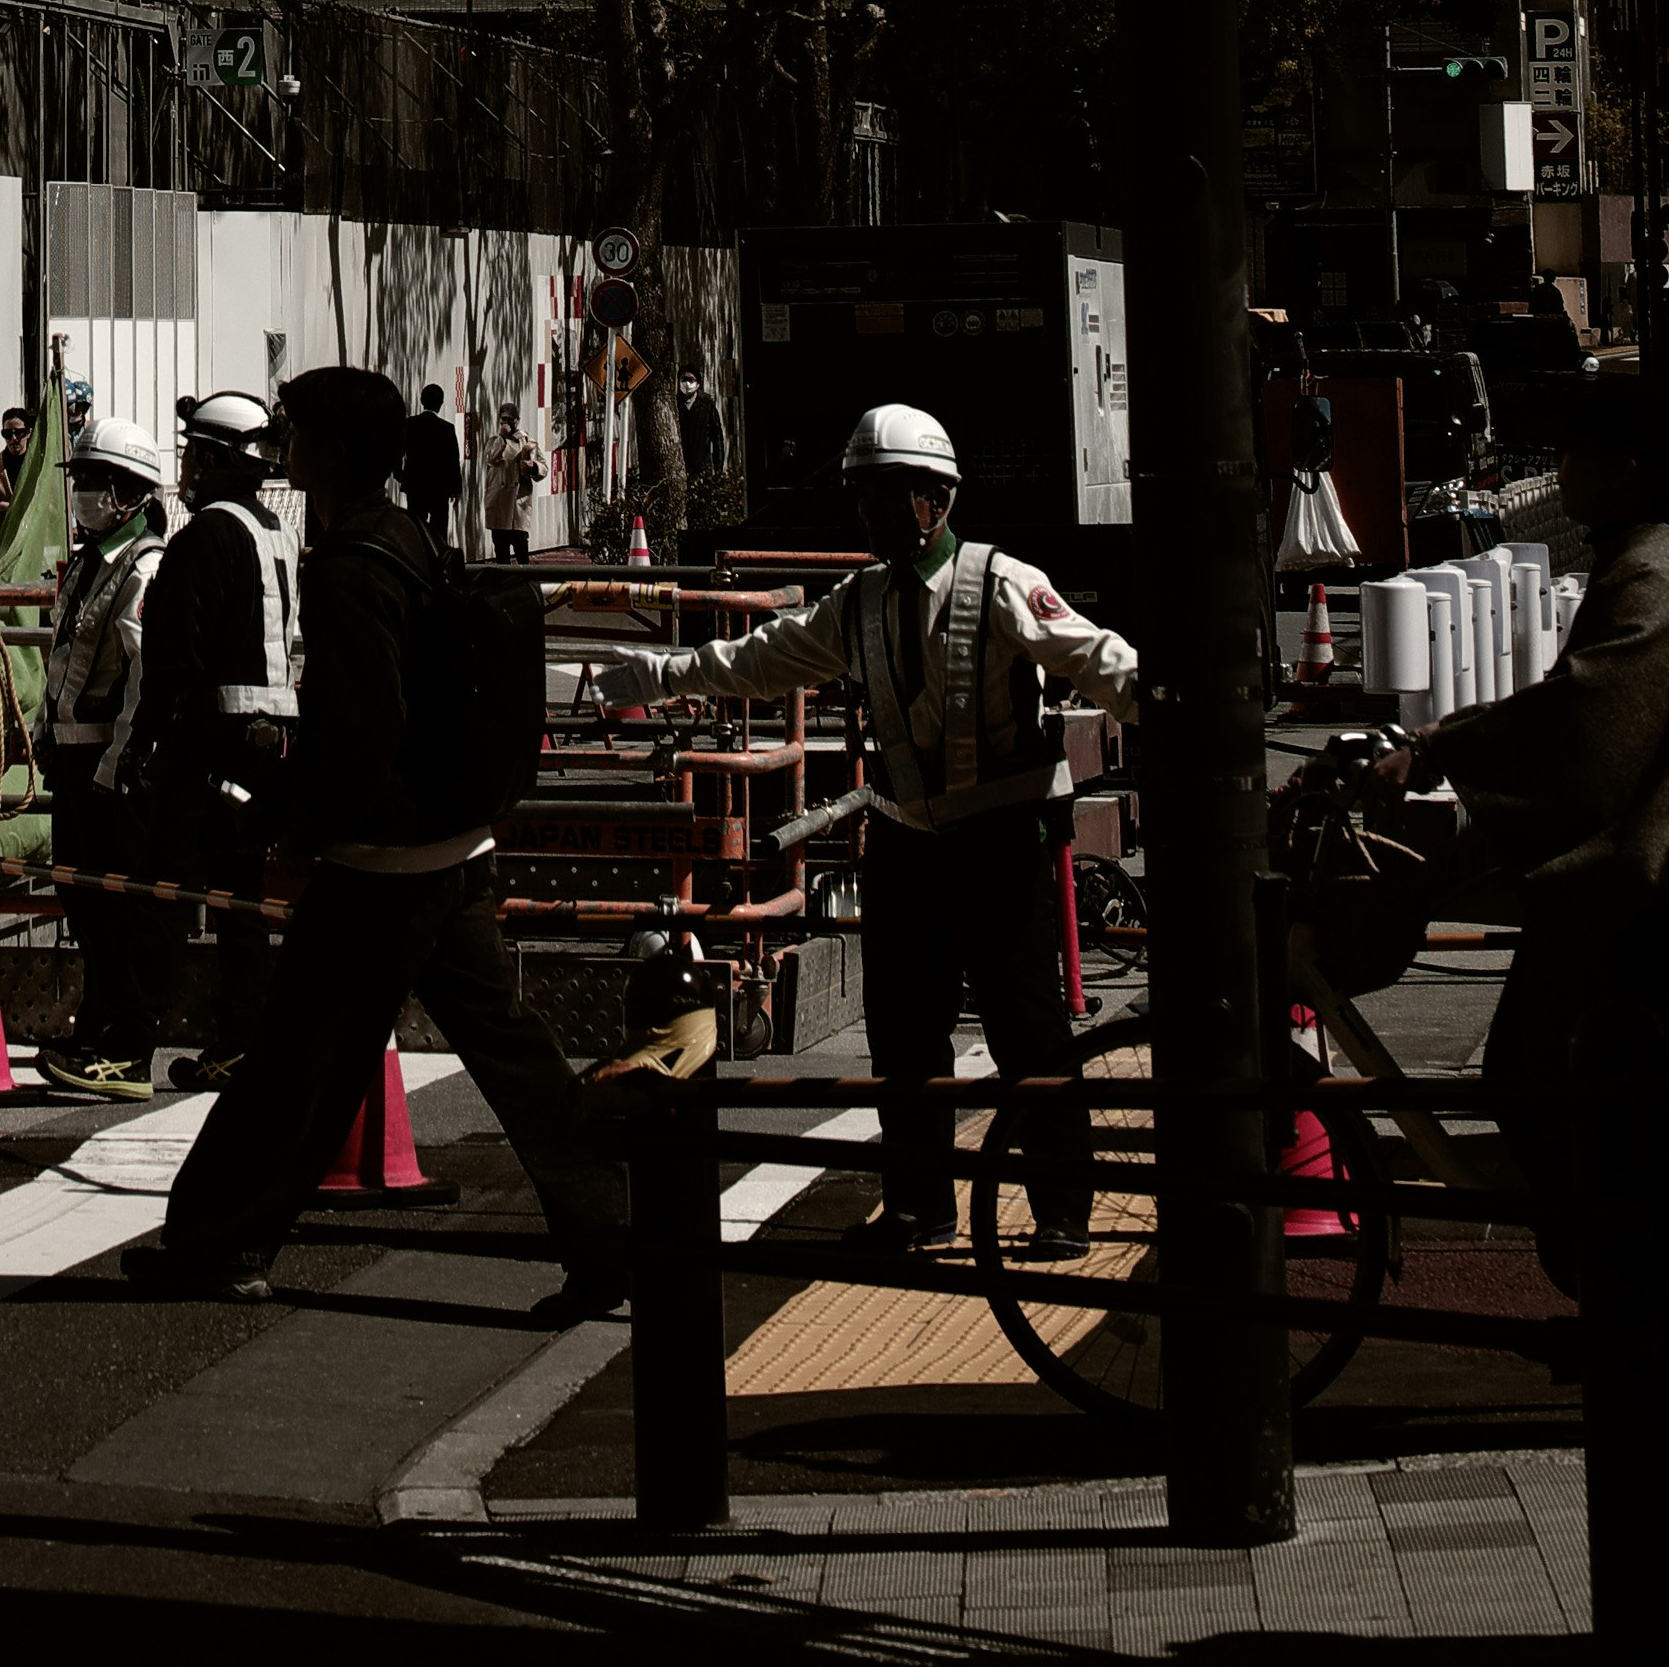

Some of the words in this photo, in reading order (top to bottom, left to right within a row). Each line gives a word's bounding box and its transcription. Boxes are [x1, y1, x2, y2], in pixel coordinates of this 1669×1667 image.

[190, 34, 212, 46] GATE
[1535, 18, 1570, 59] P
[217, 49, 234, 67] 西
[237, 35, 256, 78] 2
[1552, 47, 1573, 58] 24H
[1541, 164, 1571, 179] 赤坂
[604, 241, 629, 263] 30
[501, 825, 602, 850] JAPAN
[613, 826, 721, 853] STEELS
